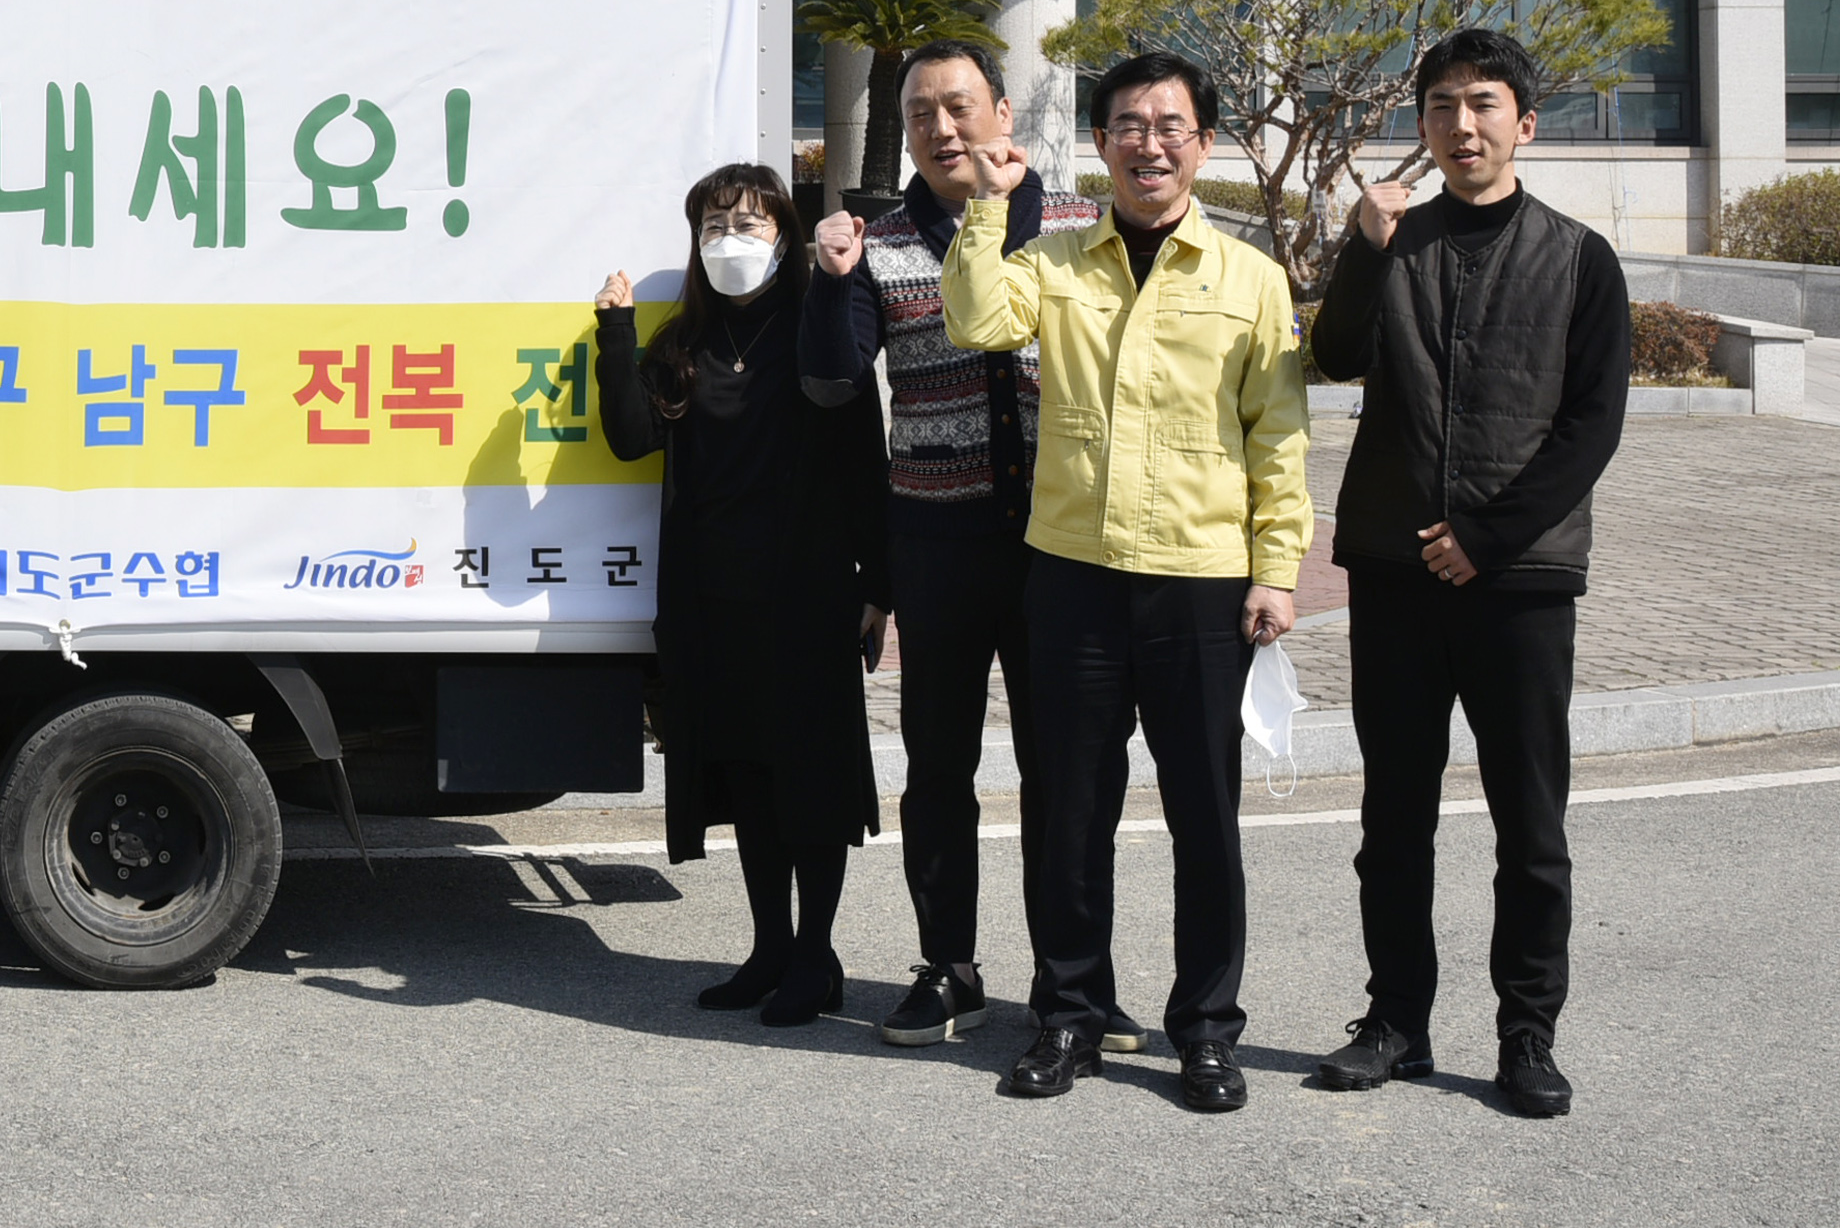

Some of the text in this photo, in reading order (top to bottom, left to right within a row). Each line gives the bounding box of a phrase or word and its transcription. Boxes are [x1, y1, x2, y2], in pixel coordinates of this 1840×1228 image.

[76, 344, 247, 448] 남구
[293, 343, 465, 447] 전복
[283, 555, 402, 590] Jindo
